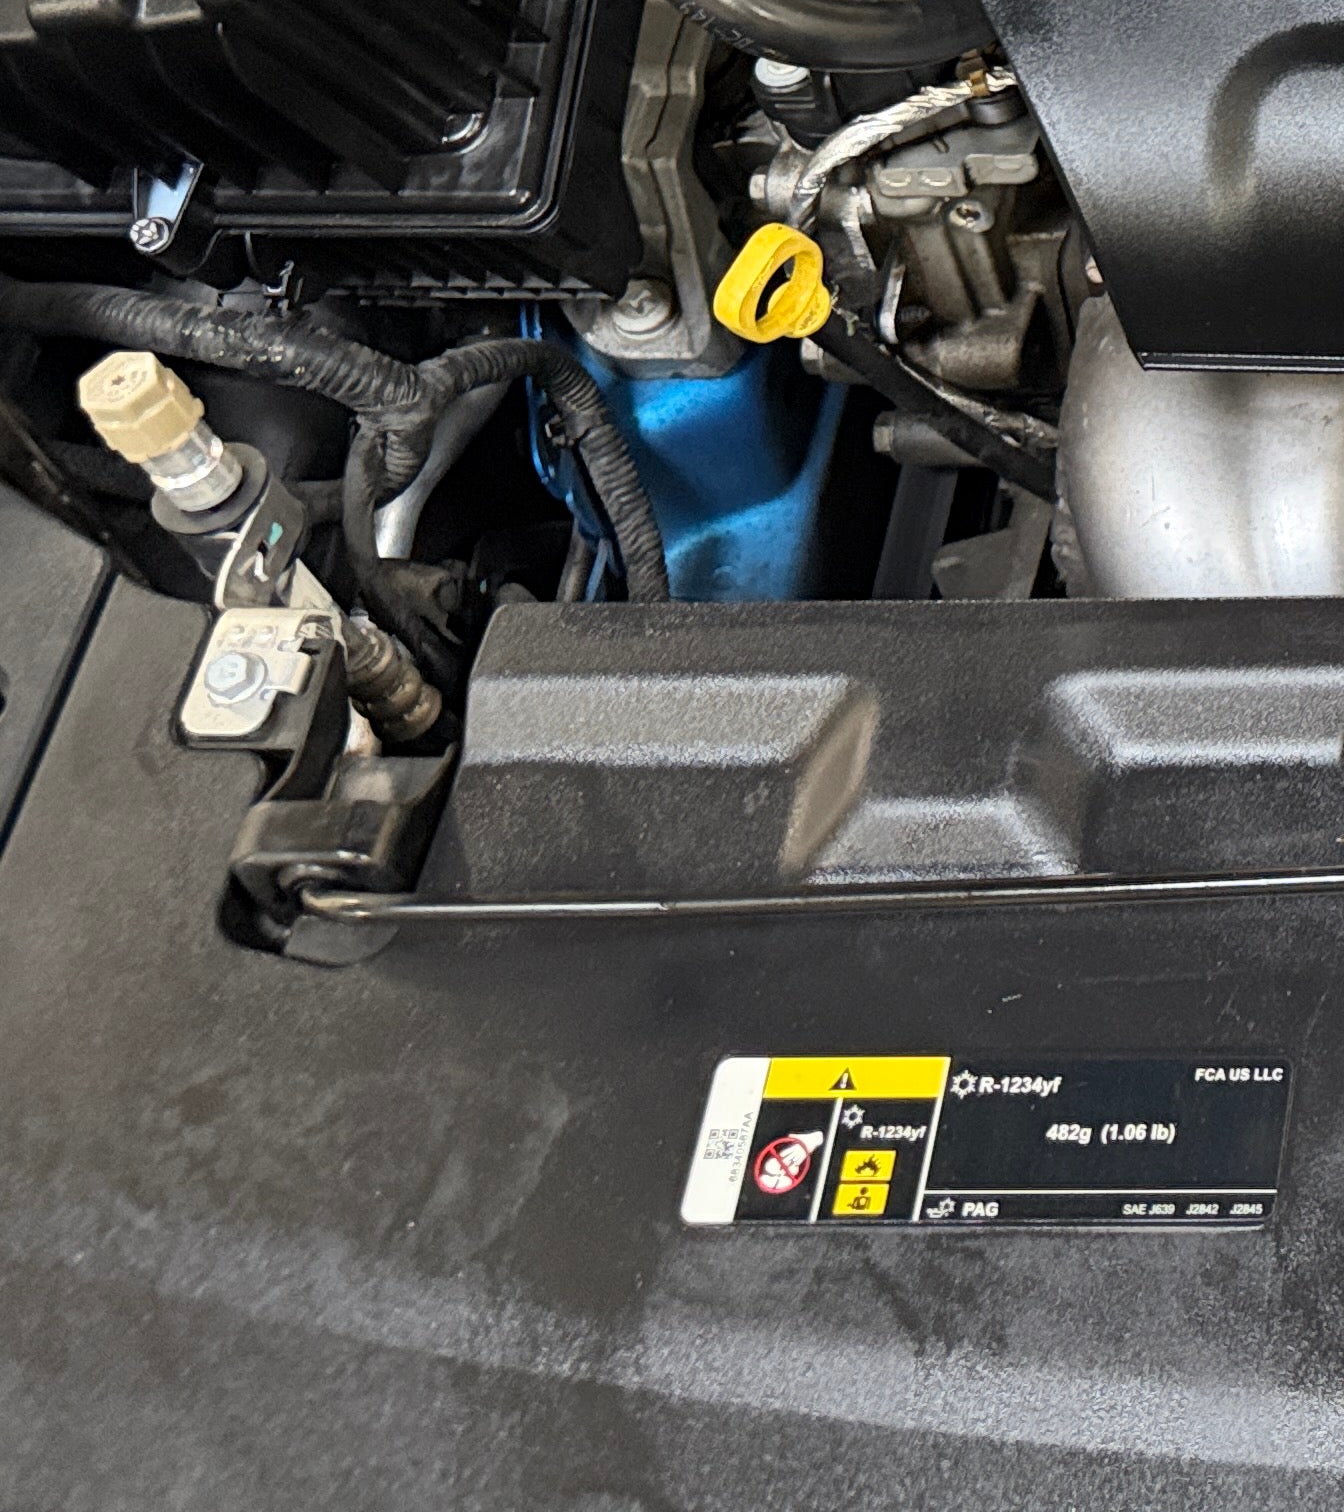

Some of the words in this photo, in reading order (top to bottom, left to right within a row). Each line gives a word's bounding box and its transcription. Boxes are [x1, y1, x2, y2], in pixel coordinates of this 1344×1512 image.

[1195, 1068, 1226, 1082] FCA
[1229, 1068, 1250, 1082] US
[1253, 1068, 1284, 1082] LLC
[979, 1076, 1063, 1097] R-1234yf
[859, 1125, 928, 1142] R-1234yf
[1046, 1124, 1093, 1144] 482g
[1101, 1123, 1147, 1144] (1.06
[1151, 1123, 1177, 1144] lb)
[961, 1201, 1000, 1218] PAG
[1122, 1203, 1146, 1215] SAE
[1149, 1203, 1176, 1216] J639
